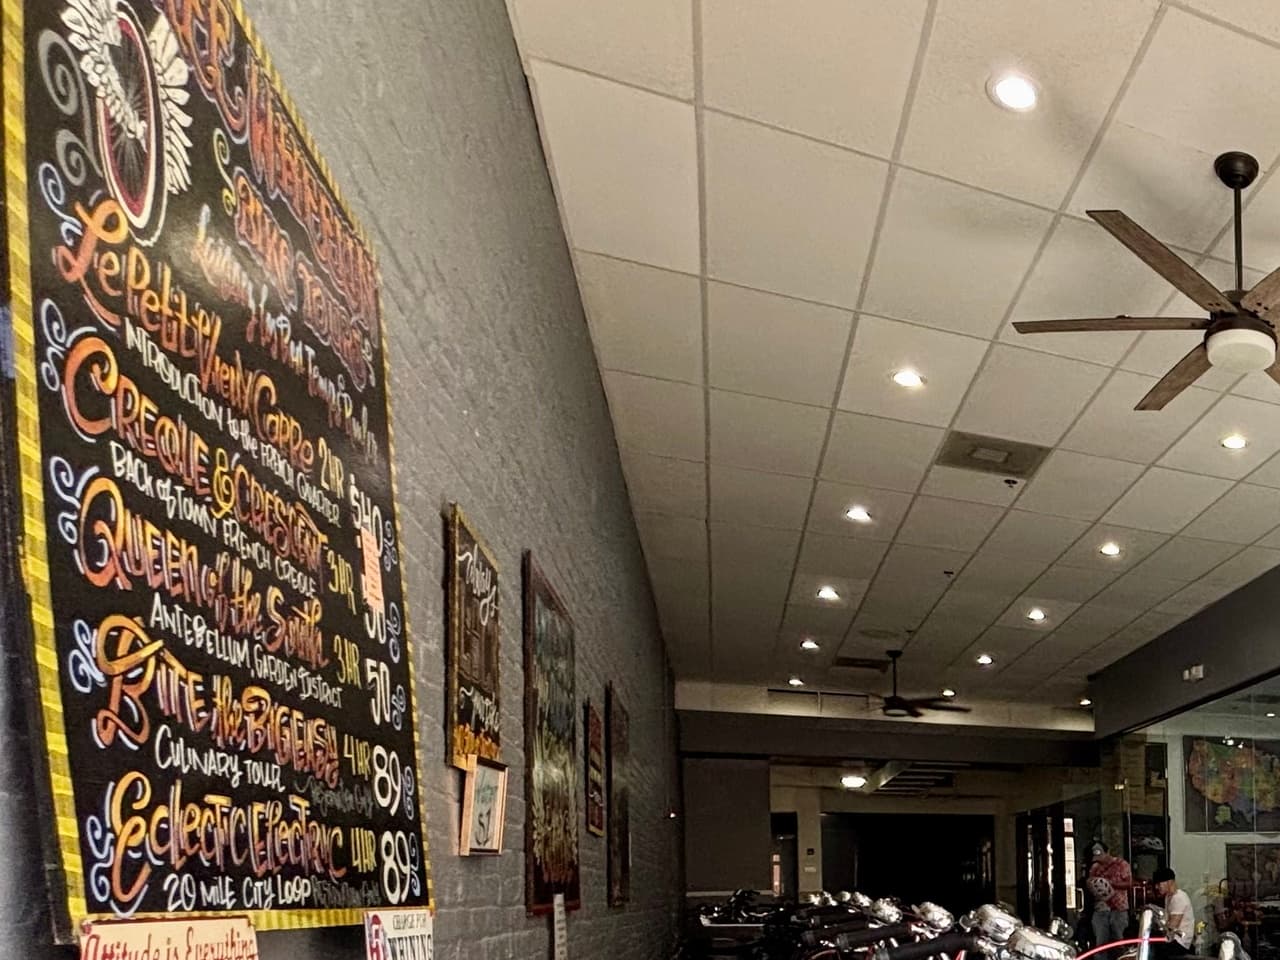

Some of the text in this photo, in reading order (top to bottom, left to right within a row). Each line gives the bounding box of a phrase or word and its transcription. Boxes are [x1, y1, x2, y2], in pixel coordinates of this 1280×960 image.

[237, 170, 297, 310] BIKE
[110, 441, 153, 497] BACK
[222, 518, 271, 571] FRENCH
[275, 556, 317, 599] CREOLE
[253, 644, 298, 692] GARDEN
[366, 658, 391, 726] 50
[155, 724, 286, 792] CULINARY TOUR
[372, 745, 401, 817] 89
[163, 873, 196, 911] 20
[381, 831, 410, 904] 89
